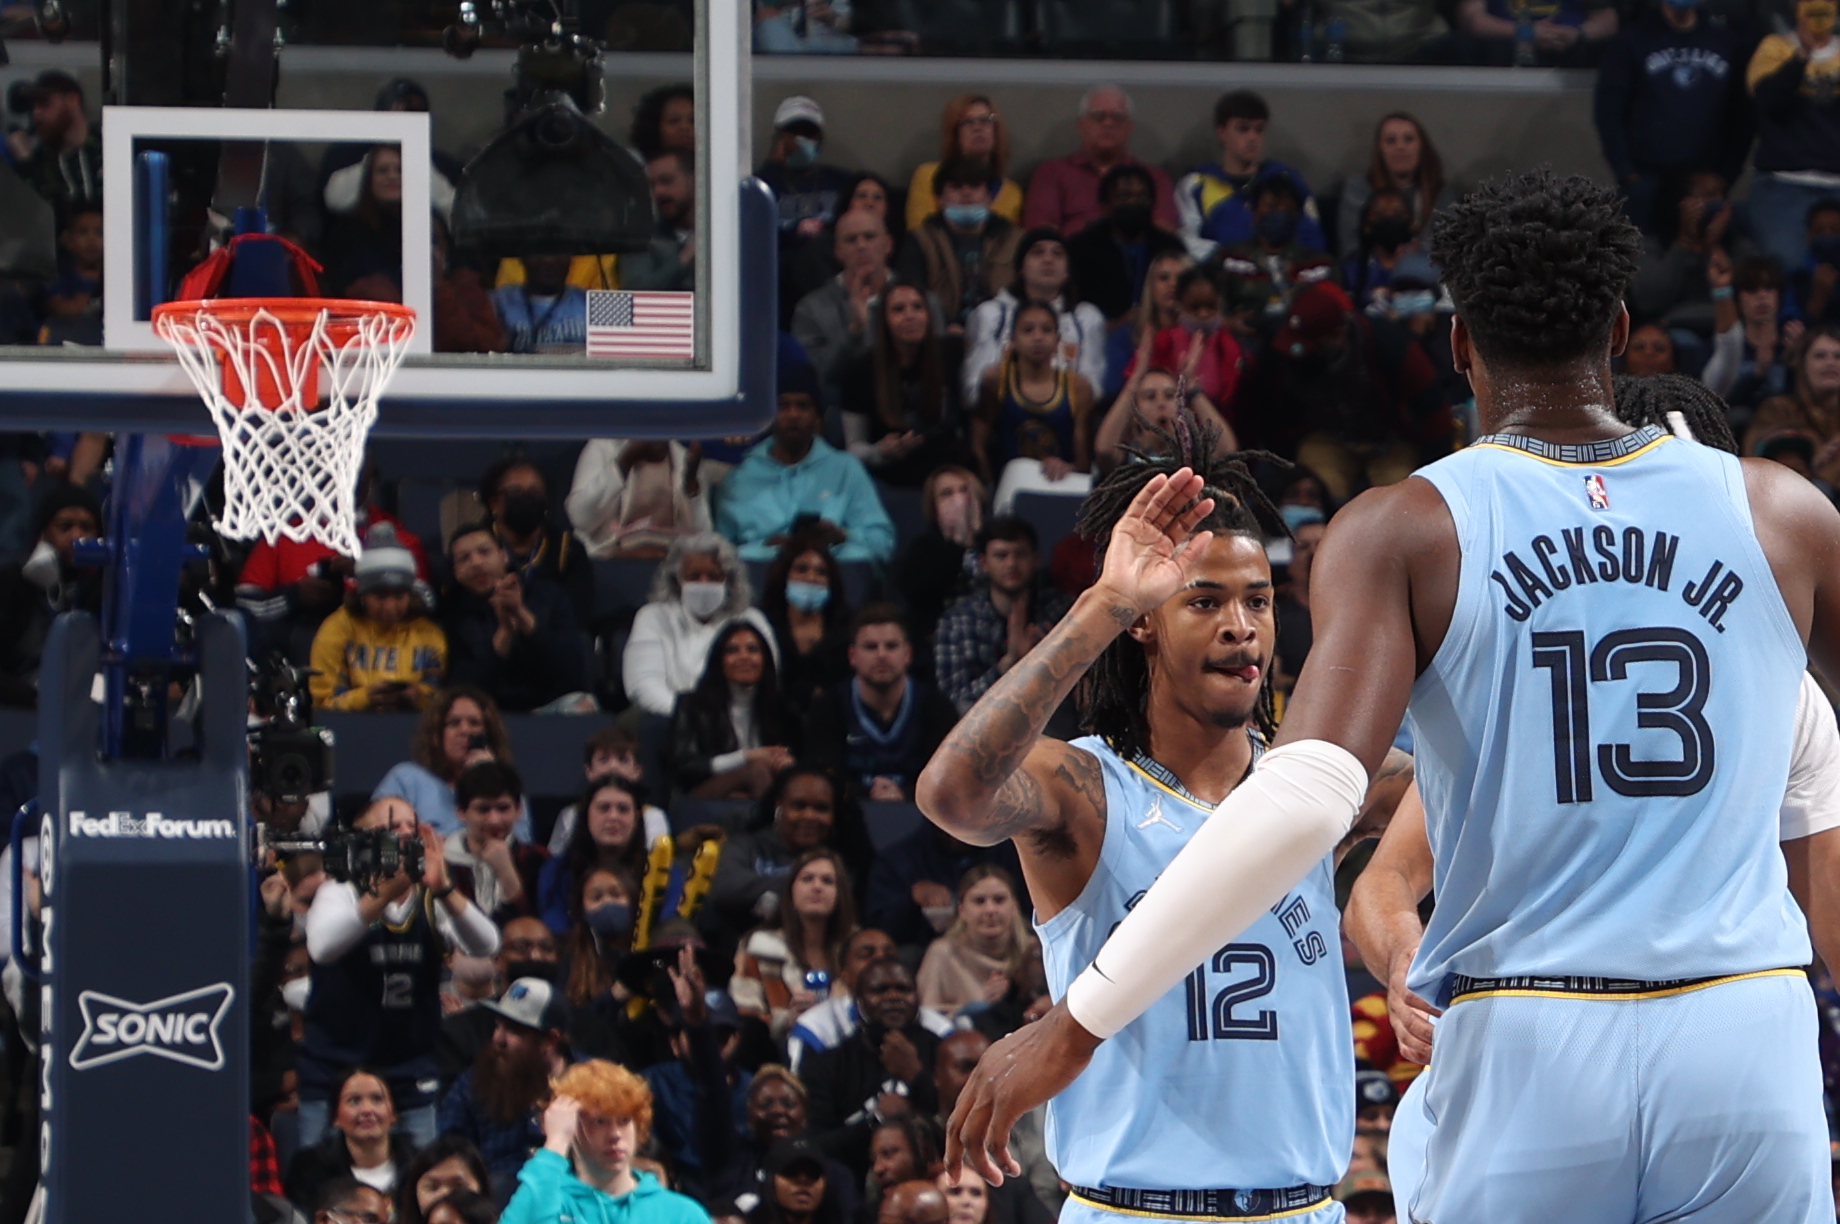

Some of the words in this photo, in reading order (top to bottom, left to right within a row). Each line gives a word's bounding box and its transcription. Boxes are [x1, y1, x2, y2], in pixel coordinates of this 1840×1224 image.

[1491, 525, 1680, 622] JACKSON
[1682, 559, 1744, 634] JR.
[1531, 627, 1715, 804] 13
[91, 1012, 209, 1045] SONIC
[1186, 943, 1278, 1041] 12
